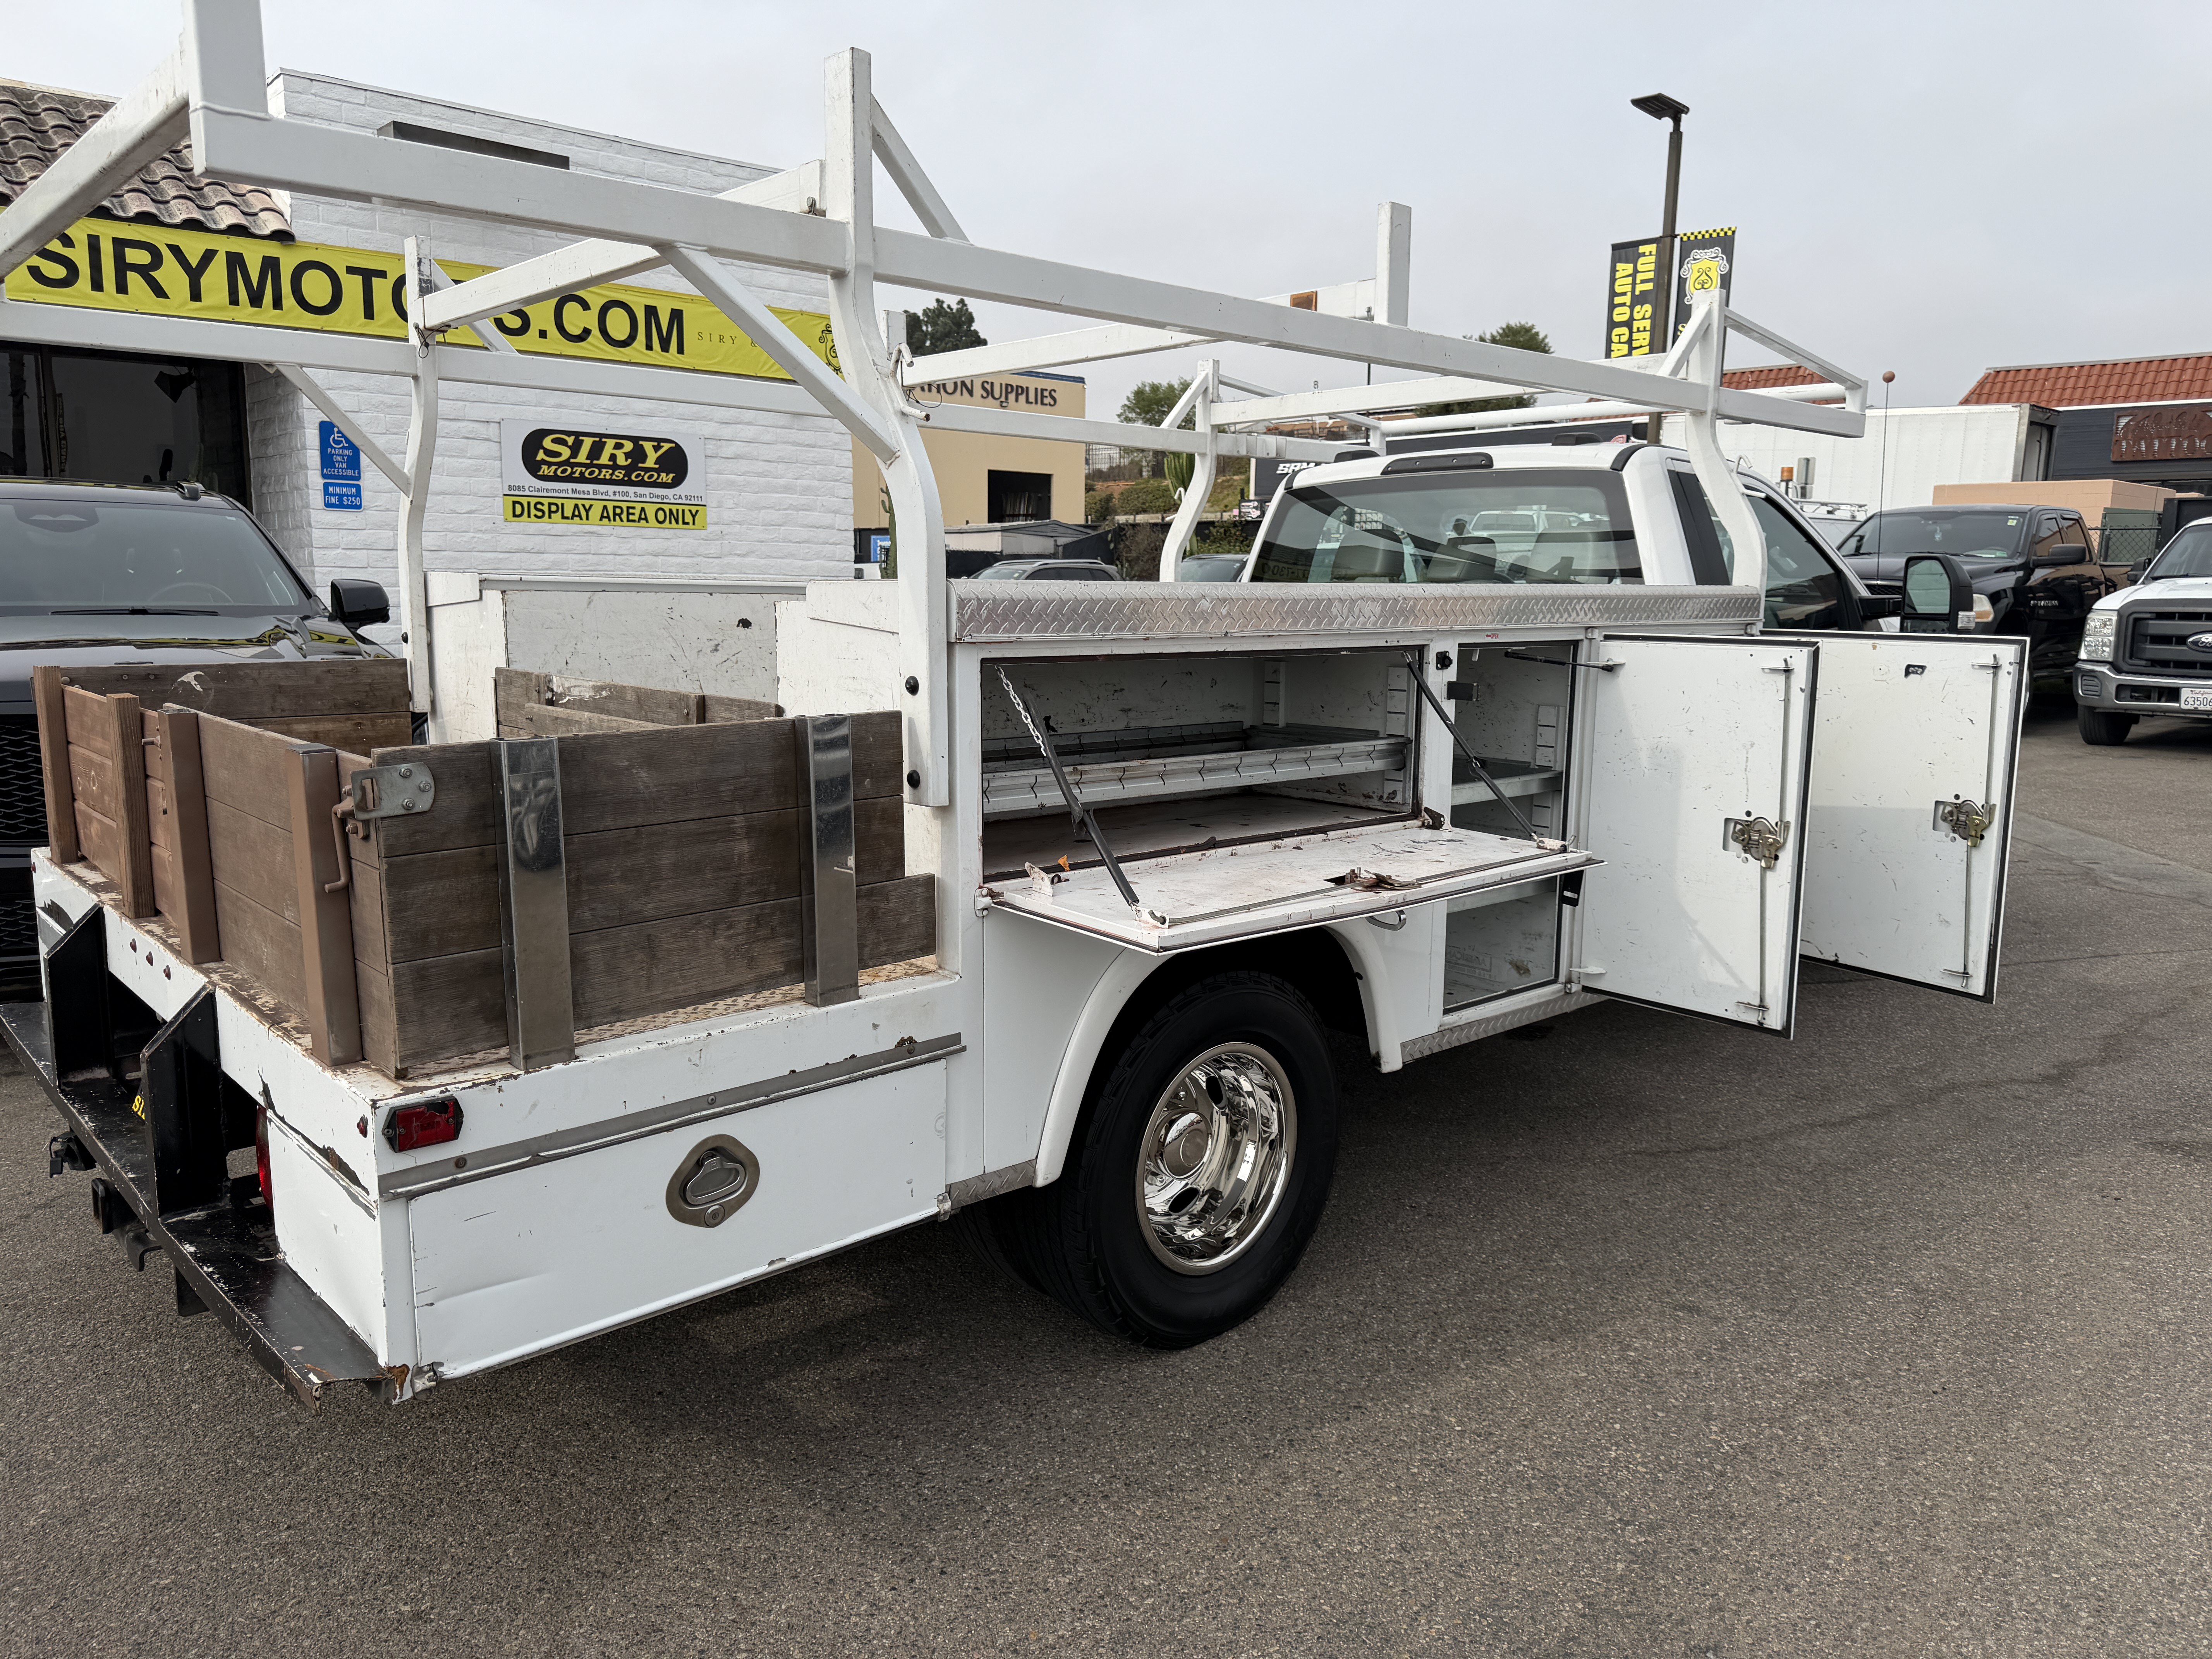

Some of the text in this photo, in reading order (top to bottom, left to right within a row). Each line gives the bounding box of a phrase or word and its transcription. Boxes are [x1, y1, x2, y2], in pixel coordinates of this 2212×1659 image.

[1635, 244, 1657, 295] FULL
[1611, 263, 1633, 358] AUTO CA
[697, 332, 737, 344] SIRY
[981, 380, 1057, 407] SUPPLIES
[535, 434, 675, 468] SIRY
[537, 465, 675, 483] MOTORS.COM
[325, 496, 361, 505] FINE $250
[329, 486, 356, 495] MINIMUM
[528, 486, 569, 494] Clairemont
[592, 489, 611, 498] Blvd,
[649, 493, 671, 501] Diego,
[512, 500, 700, 526] DISPLAY AREA ONLY
